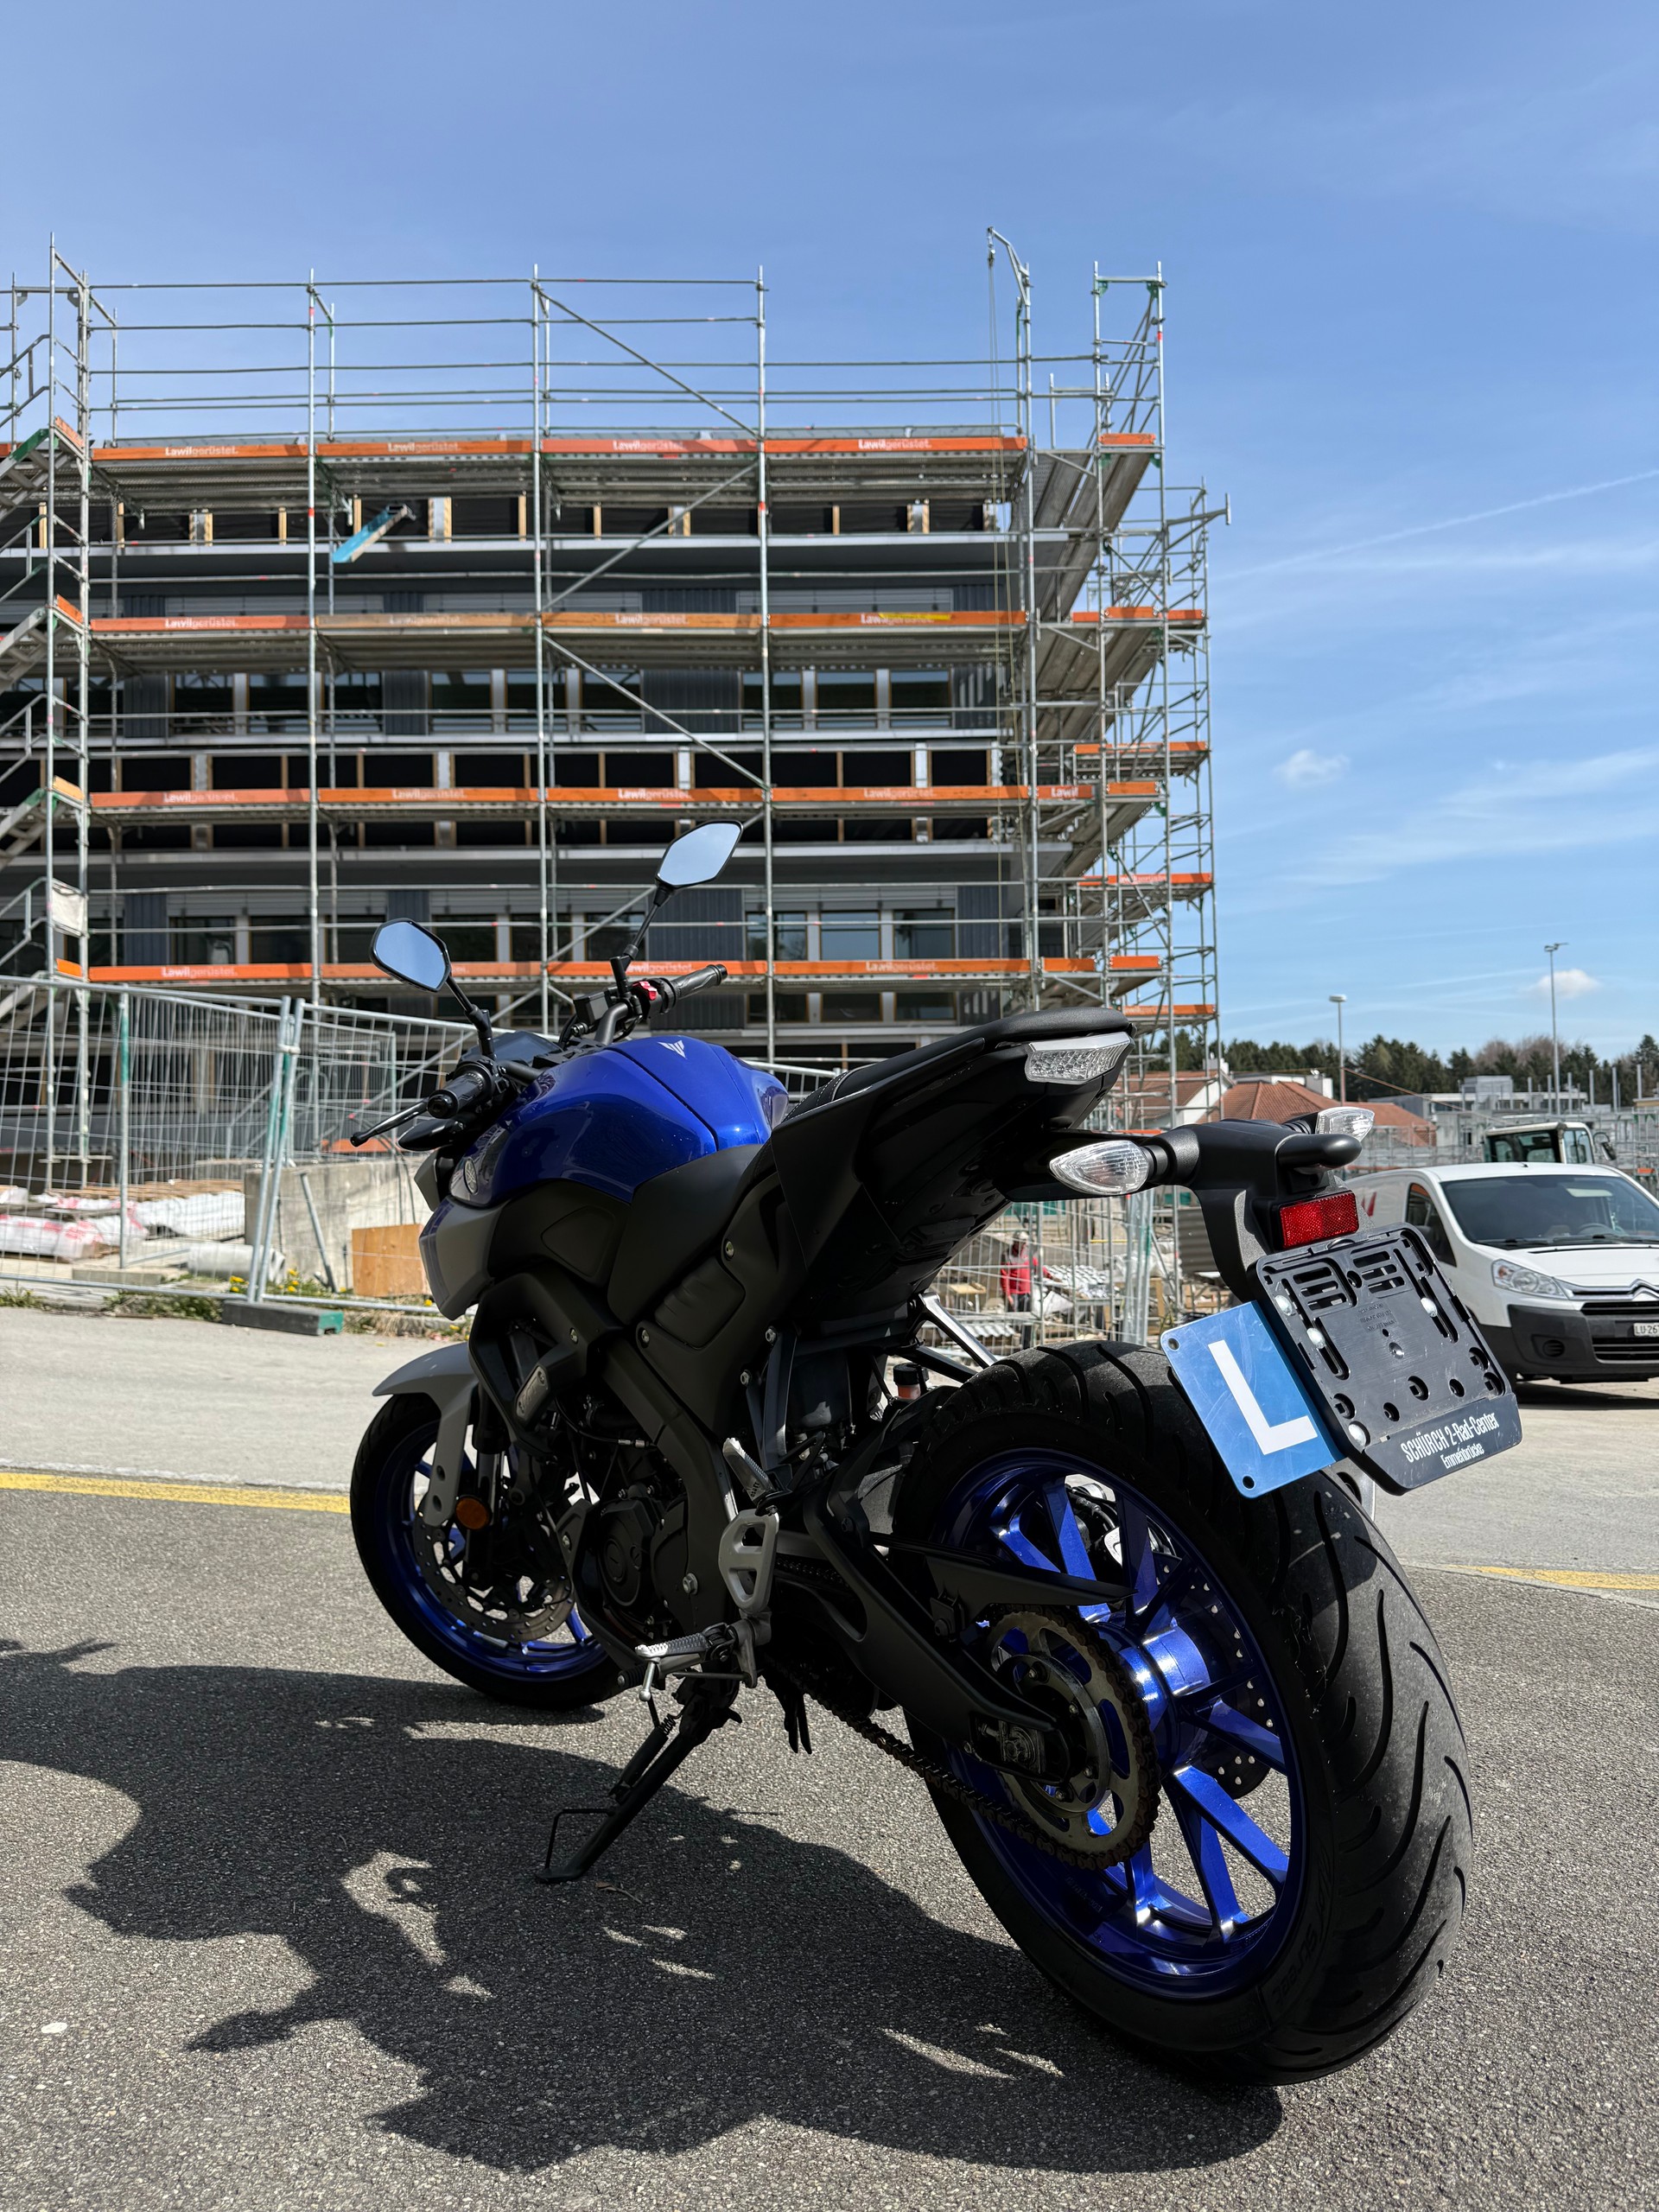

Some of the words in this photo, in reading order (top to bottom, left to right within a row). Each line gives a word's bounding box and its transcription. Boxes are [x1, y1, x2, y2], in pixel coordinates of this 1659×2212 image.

[1208, 1339, 1318, 1455] L
[1400, 1429, 1450, 1463] SCHÜRCH
[1445, 1412, 1500, 1446] 2-Rad-Center
[1440, 1442, 1484, 1469] Emmenbrücke
